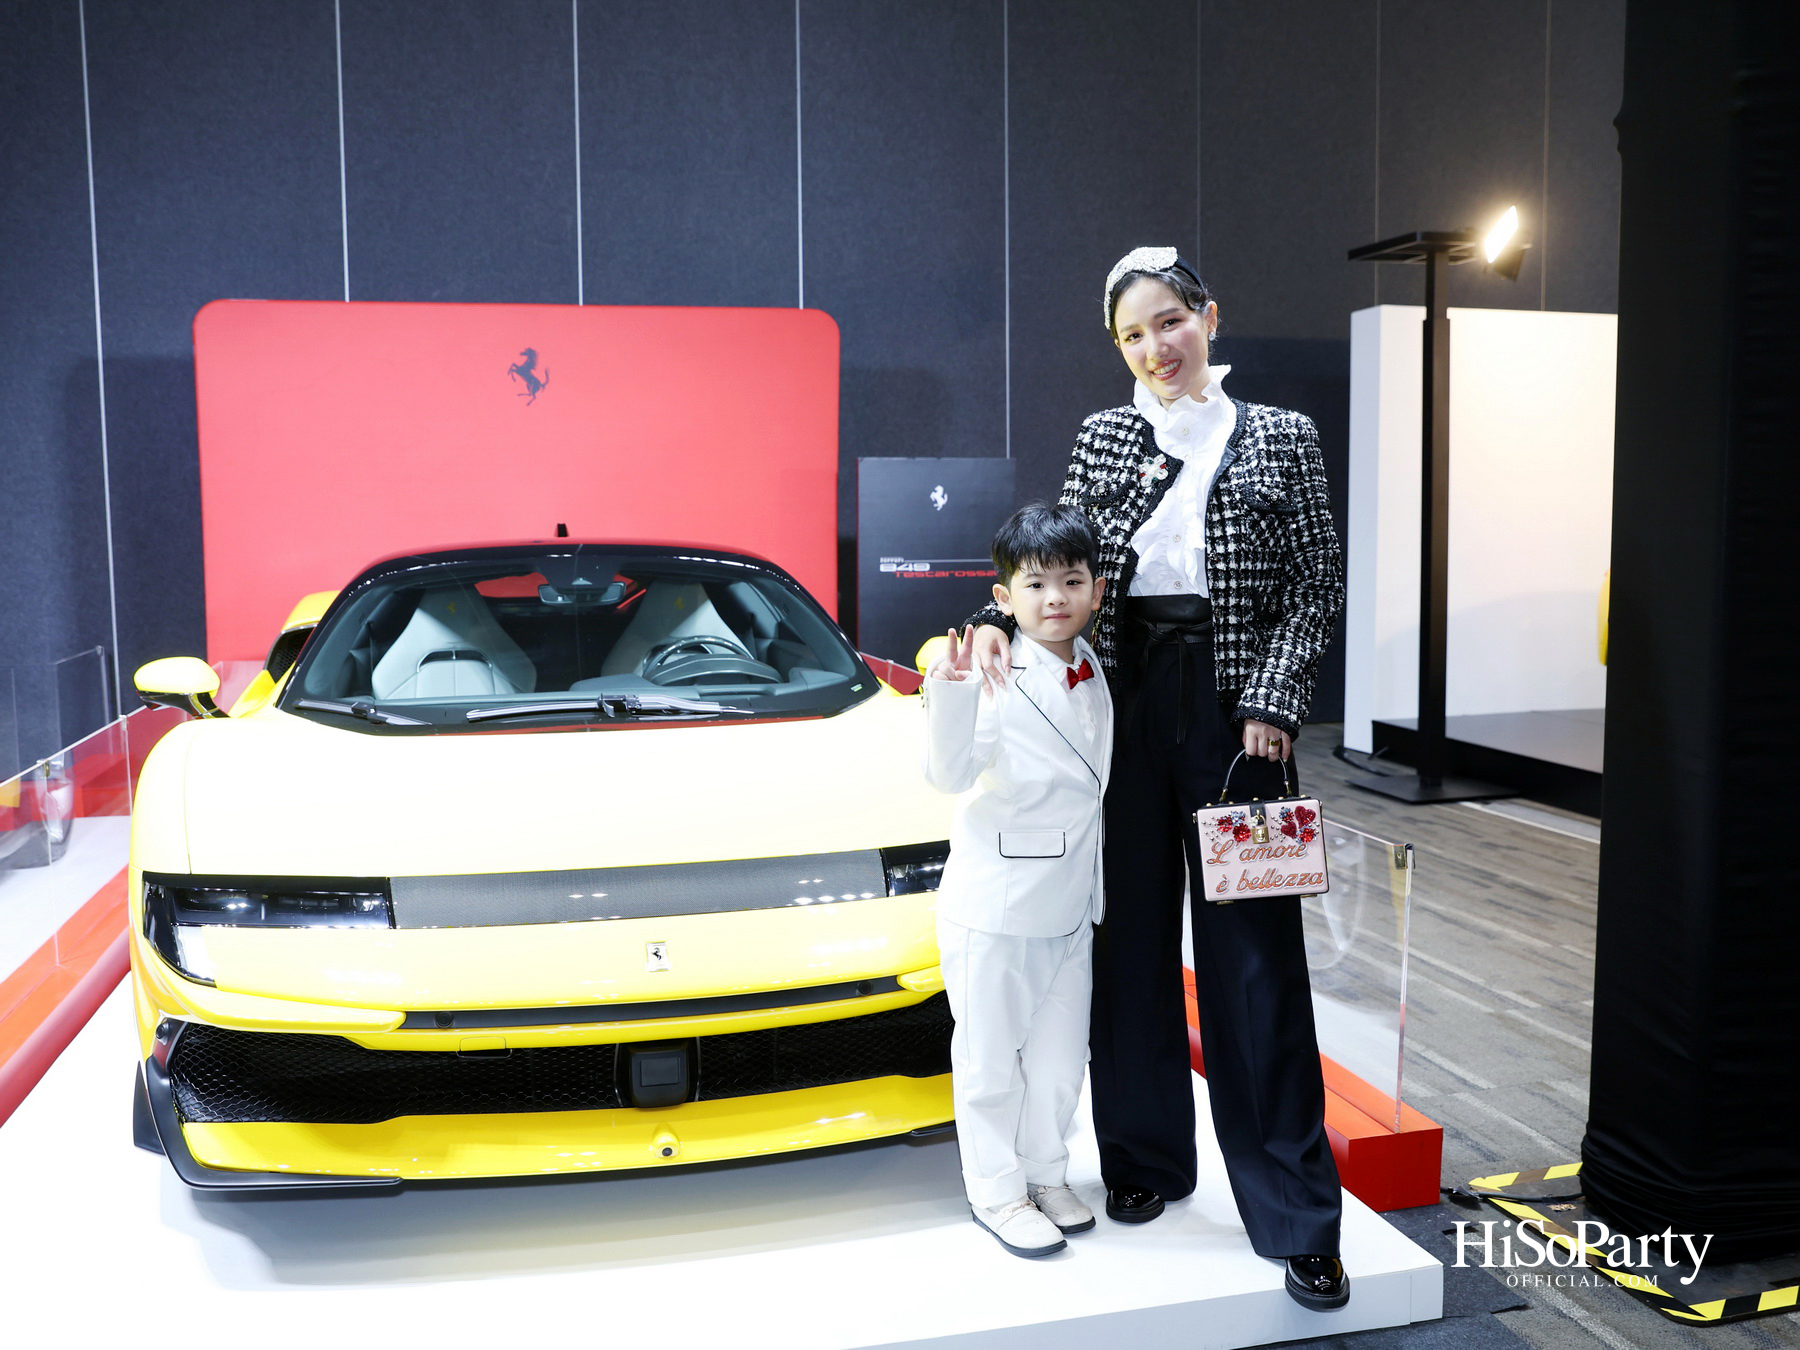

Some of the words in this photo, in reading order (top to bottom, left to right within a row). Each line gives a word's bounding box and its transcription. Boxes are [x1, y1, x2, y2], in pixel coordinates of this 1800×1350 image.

[1206, 839, 1307, 865] L'amore
[1215, 874, 1229, 893] è
[1236, 868, 1324, 892] bellezza
